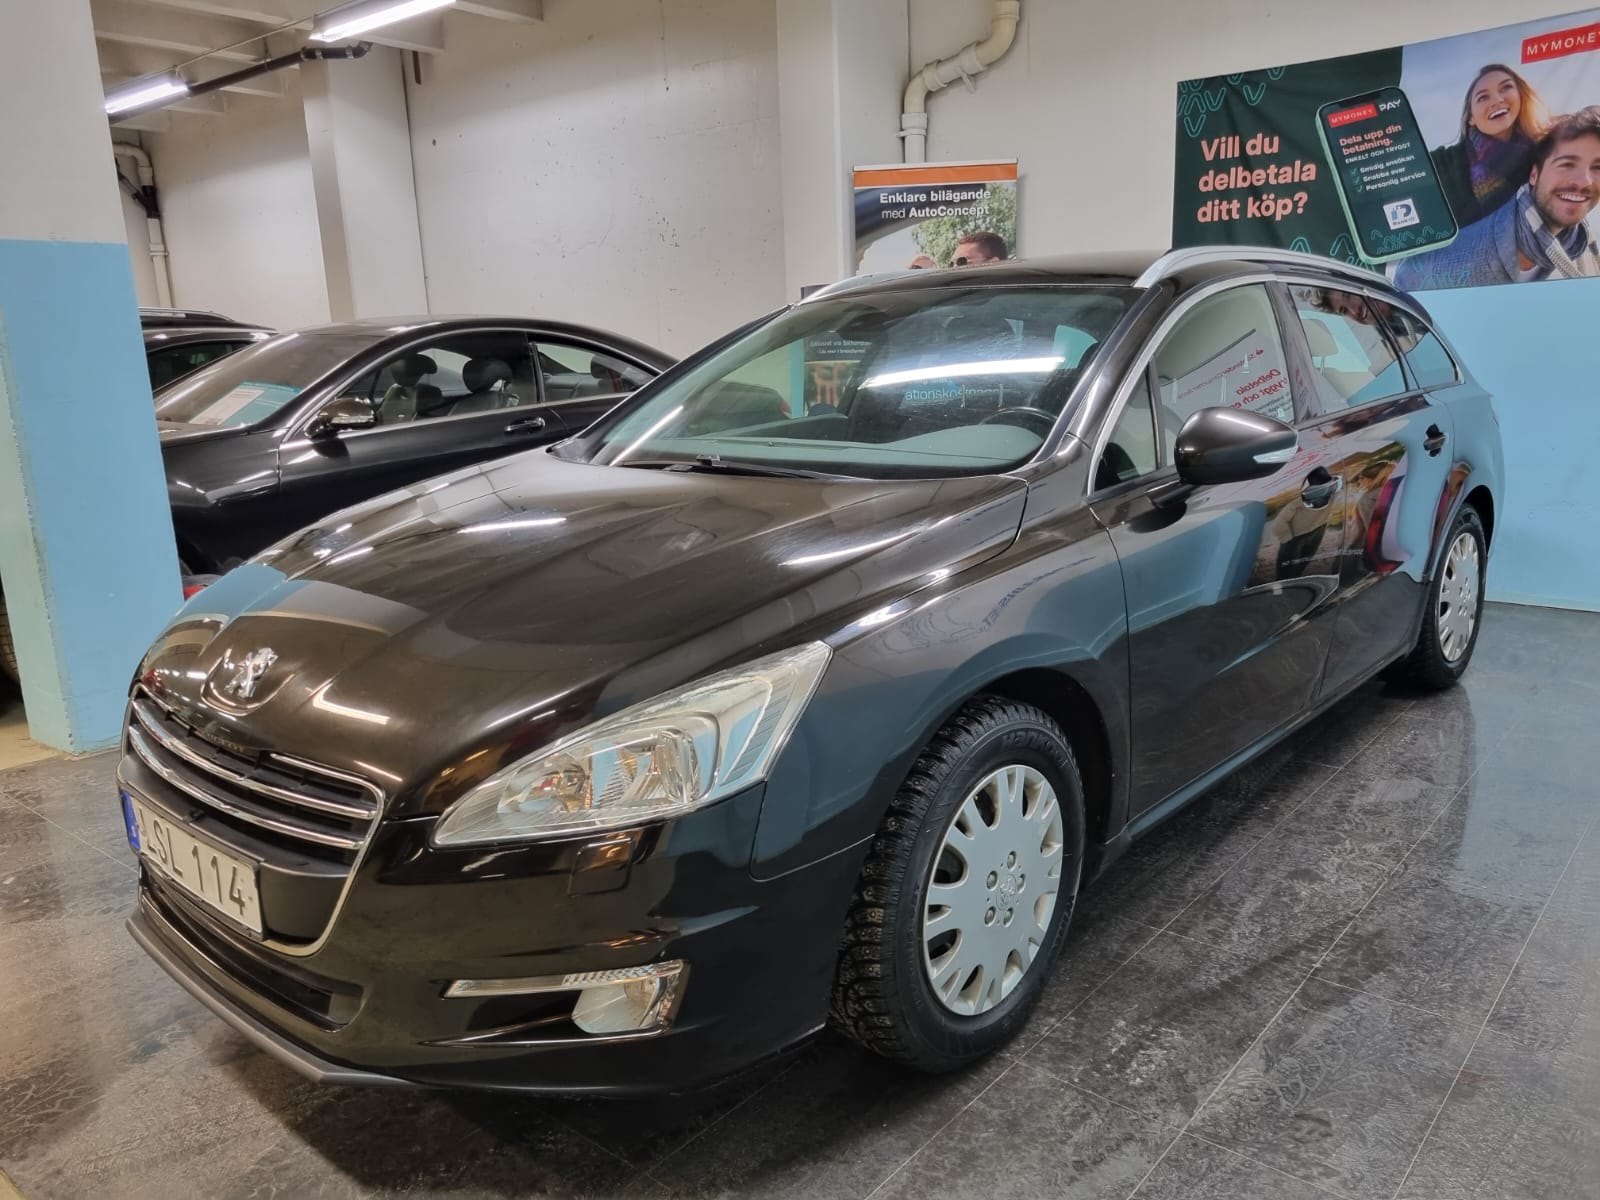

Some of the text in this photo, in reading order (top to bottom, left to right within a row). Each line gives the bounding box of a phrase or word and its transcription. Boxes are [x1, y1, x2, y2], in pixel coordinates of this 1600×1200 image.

[1527, 32, 1600, 56] MYMONE
[1331, 99, 1400, 123] MYMONEY PAY
[1339, 124, 1402, 146] Dela upp din
[1342, 138, 1393, 155] betalning.
[1201, 133, 1279, 161] Vill du
[1198, 160, 1317, 192] delbetala
[1360, 163, 1385, 174] Smidig
[1366, 171, 1426, 191] Personlig service
[880, 189, 992, 204] Enklare bilägande
[1197, 192, 1308, 222] ditt köp?
[881, 205, 990, 219] med AutoConcept
[191, 845, 246, 916] 114
